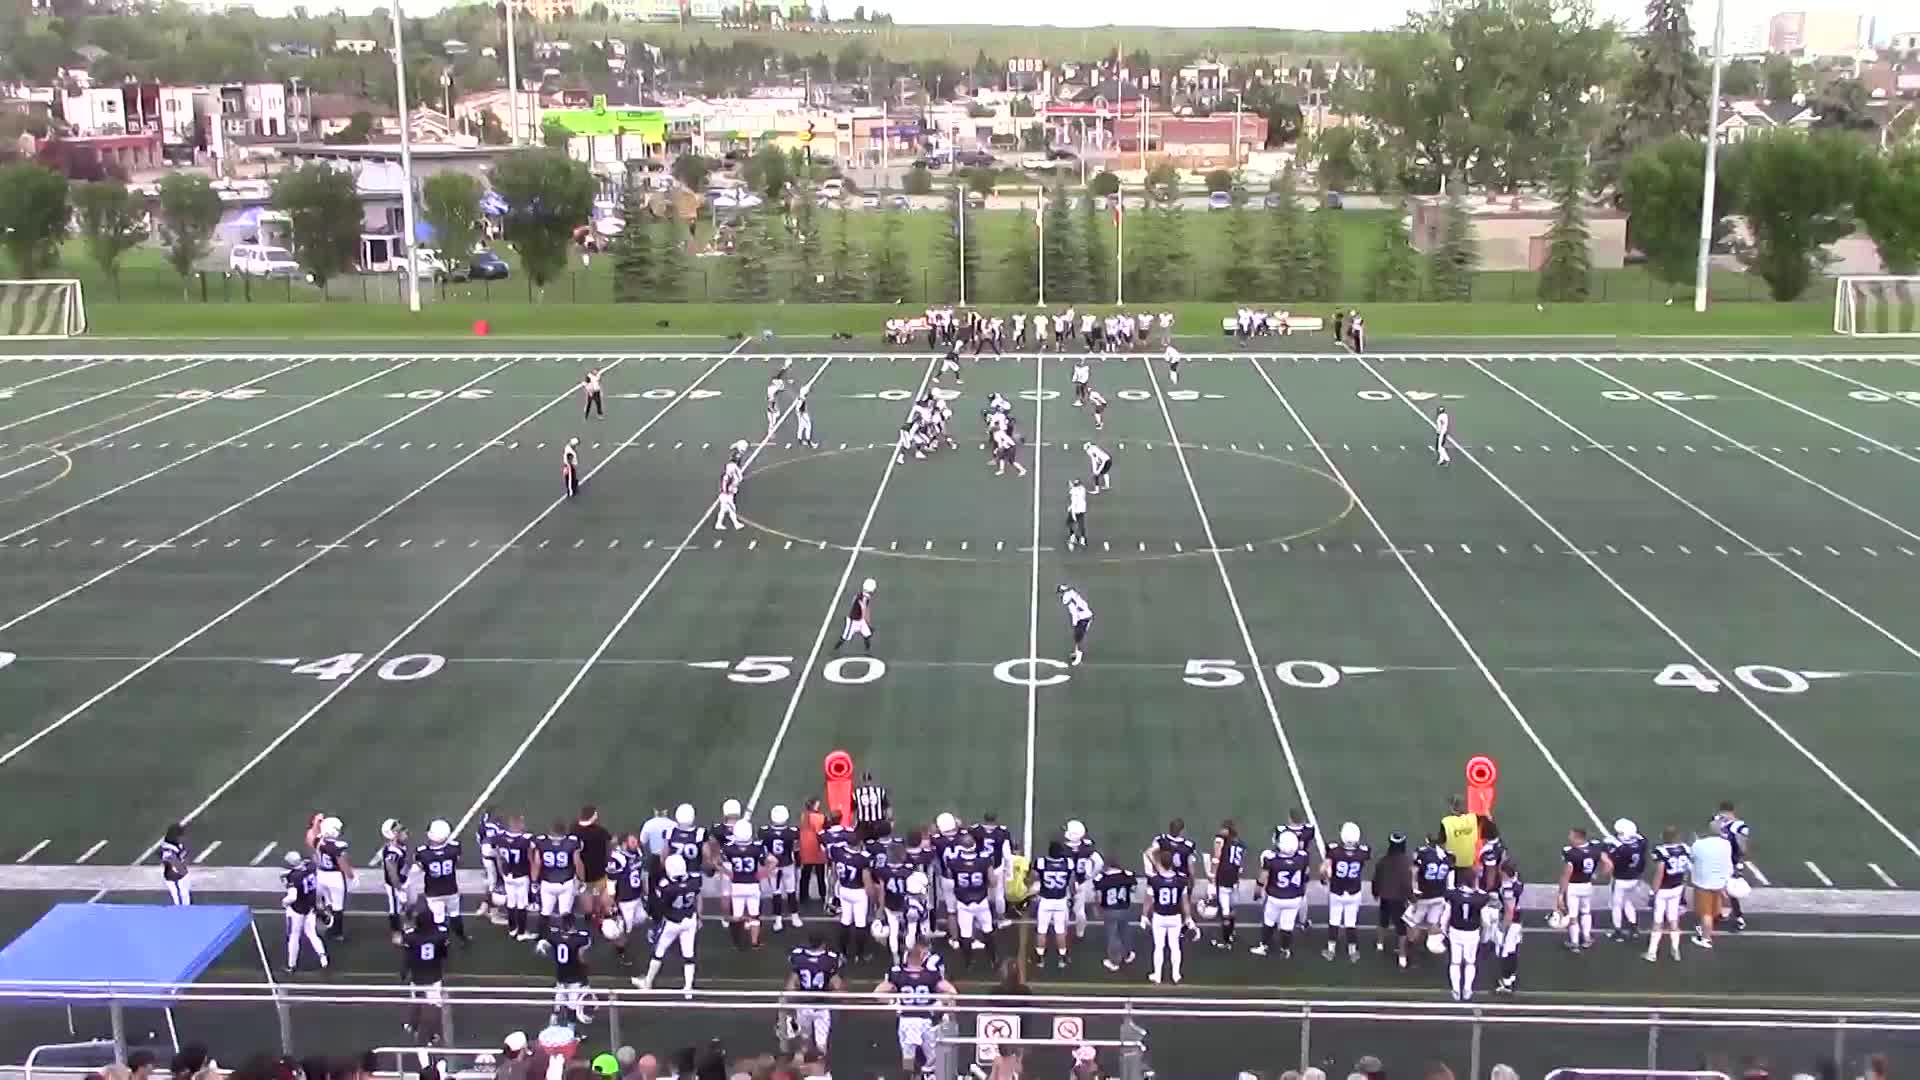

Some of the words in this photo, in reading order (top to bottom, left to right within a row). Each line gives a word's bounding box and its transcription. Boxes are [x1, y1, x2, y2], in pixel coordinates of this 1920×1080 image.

[290, 652, 446, 681] 40
[726, 655, 887, 684] 50
[992, 657, 1072, 686] C
[1181, 658, 1341, 688] 50
[1653, 663, 1810, 693] 40
[1277, 869, 1303, 888] 54
[1335, 861, 1361, 878] 92
[1158, 886, 1178, 905] 81
[556, 943, 569, 964] 0
